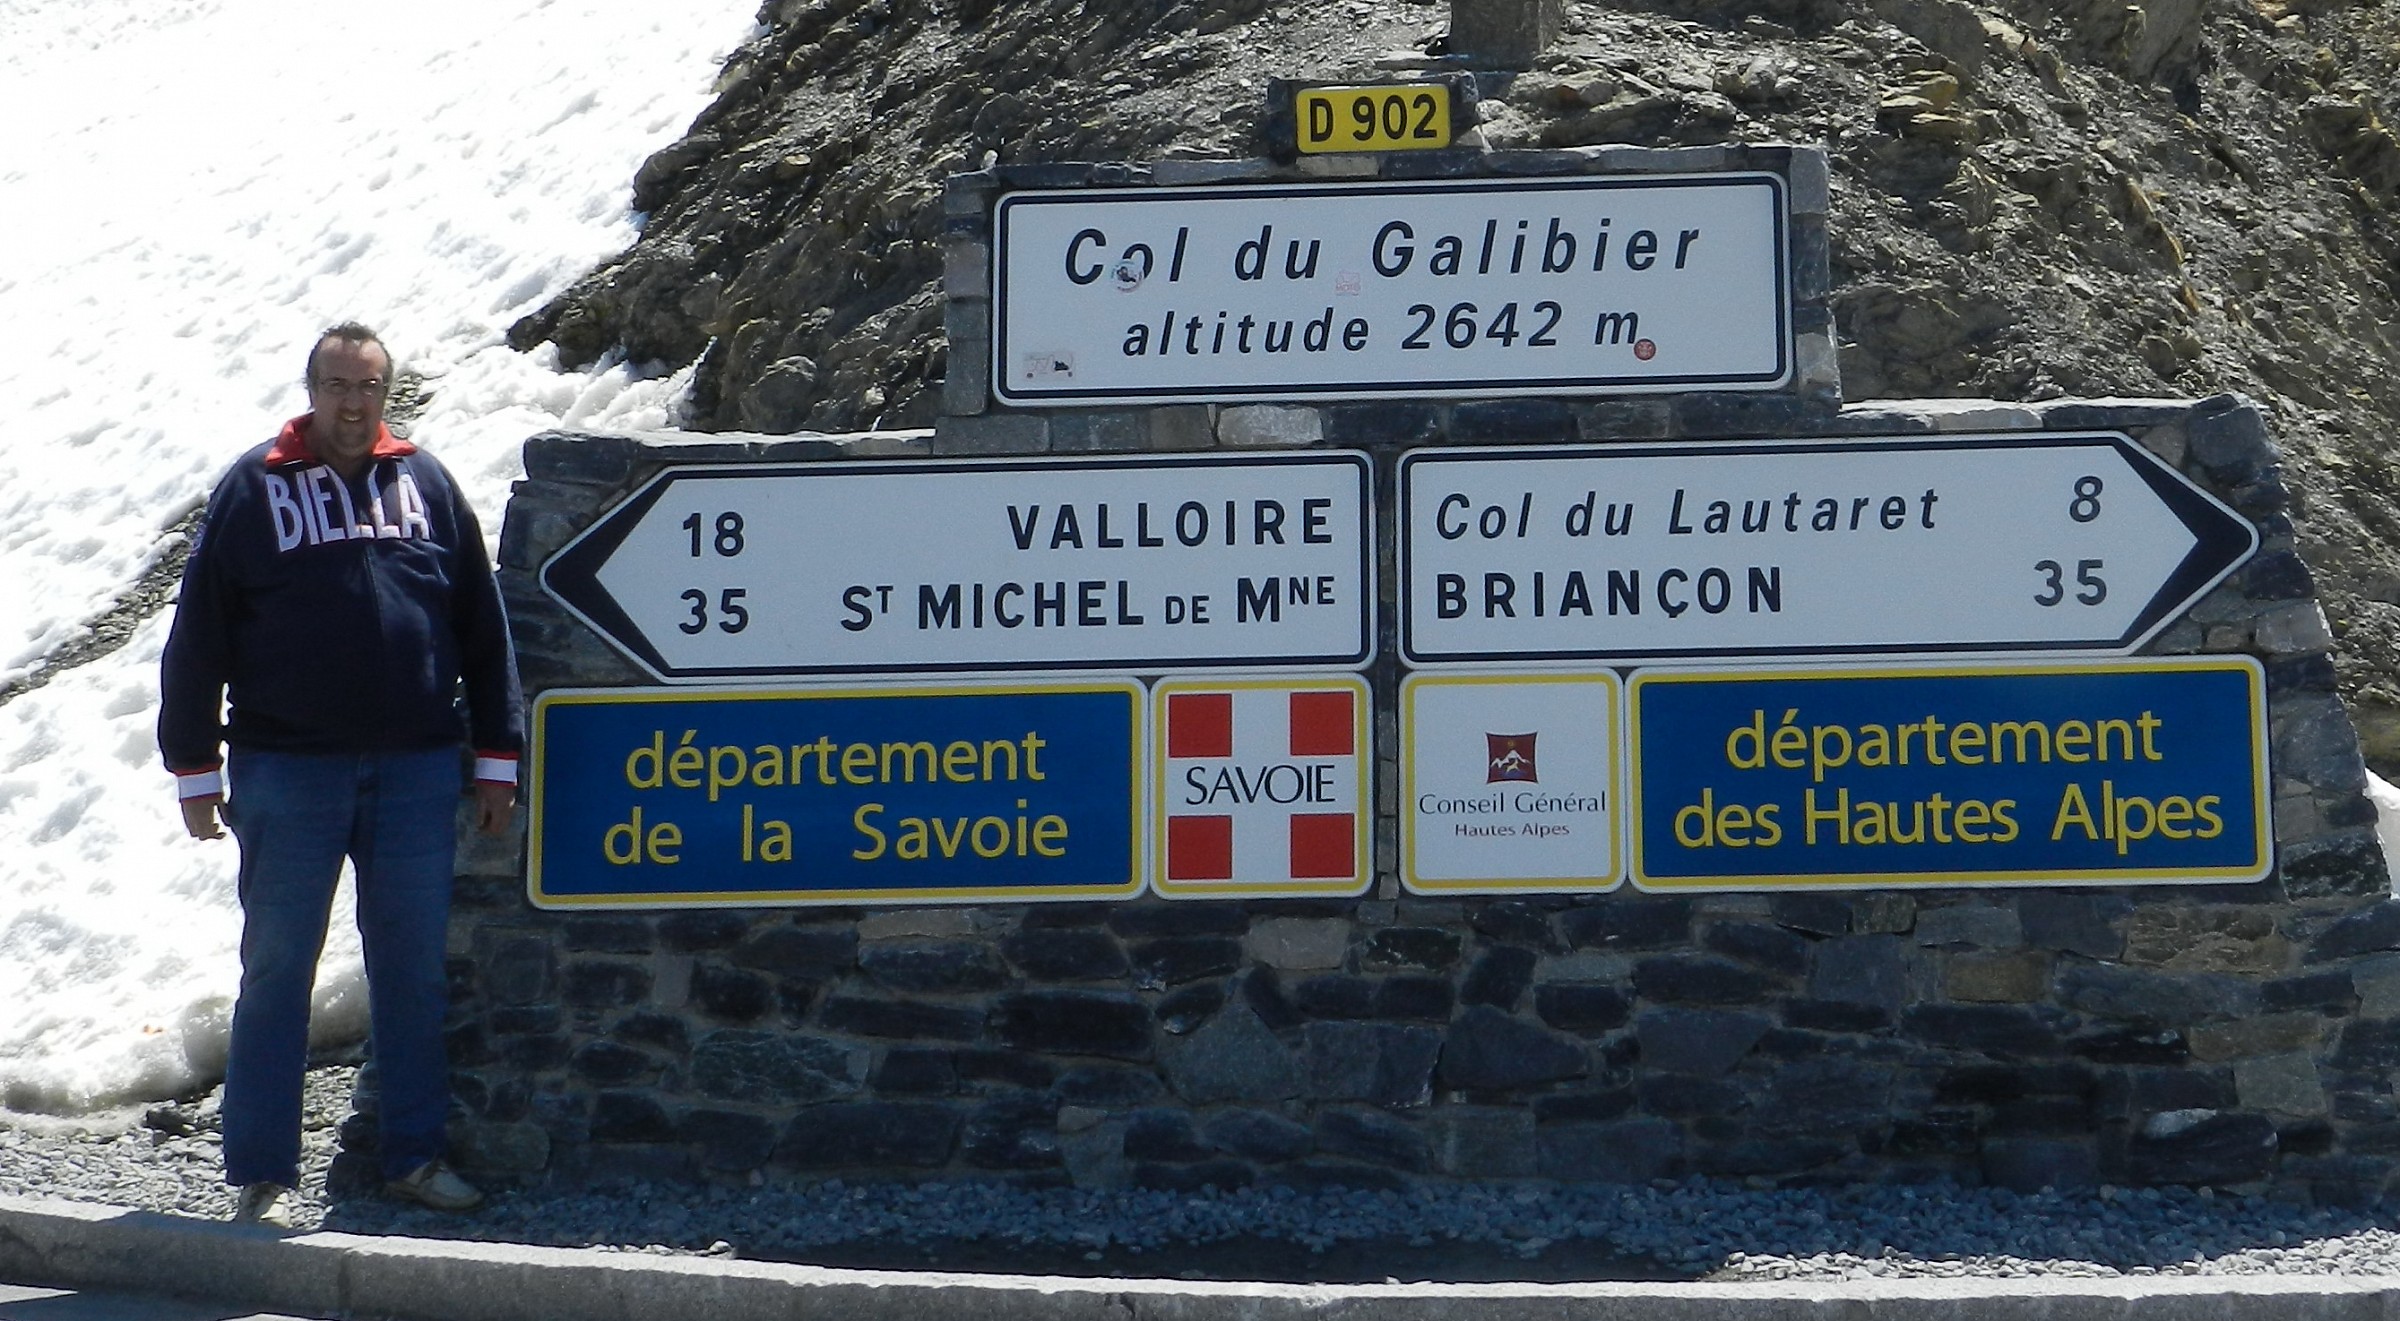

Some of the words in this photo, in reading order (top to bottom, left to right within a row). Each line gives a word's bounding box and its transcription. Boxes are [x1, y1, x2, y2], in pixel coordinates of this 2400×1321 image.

[1310, 98, 1333, 142] D
[1353, 94, 1437, 141] 902
[1066, 227, 1188, 285] Col
[1235, 225, 1320, 280] du
[1373, 218, 1699, 277] Galibier
[1123, 307, 1368, 356] altitude
[1402, 301, 1561, 349] 2642
[1595, 312, 1638, 345] m
[265, 464, 431, 553] BIELLA
[1007, 499, 1331, 550] VALLOIRE
[1437, 493, 1532, 540] Col
[1566, 491, 1633, 536] du
[1669, 489, 1938, 534] Lautaret
[2070, 476, 2103, 522] 8
[683, 512, 744, 557] 18
[919, 581, 1143, 629] MICHEL
[1166, 596, 1209, 624] DE
[1437, 567, 1780, 618] BRIANÇON
[2034, 560, 2106, 606] 35
[679, 589, 748, 634] 35
[627, 730, 1046, 797] département
[1727, 709, 2162, 778] département
[1186, 765, 1335, 805] SAVOIE
[1419, 792, 1504, 815] Conseil
[1514, 790, 1606, 814] Général
[604, 806, 682, 864] de
[743, 804, 791, 861] la
[853, 799, 1068, 859] Savoie
[1455, 824, 1516, 837] Hautes
[1521, 822, 1570, 839] Alpes
[1675, 789, 1781, 847] des
[1806, 788, 2018, 846] Hautes
[2052, 780, 2223, 854] Alpes
